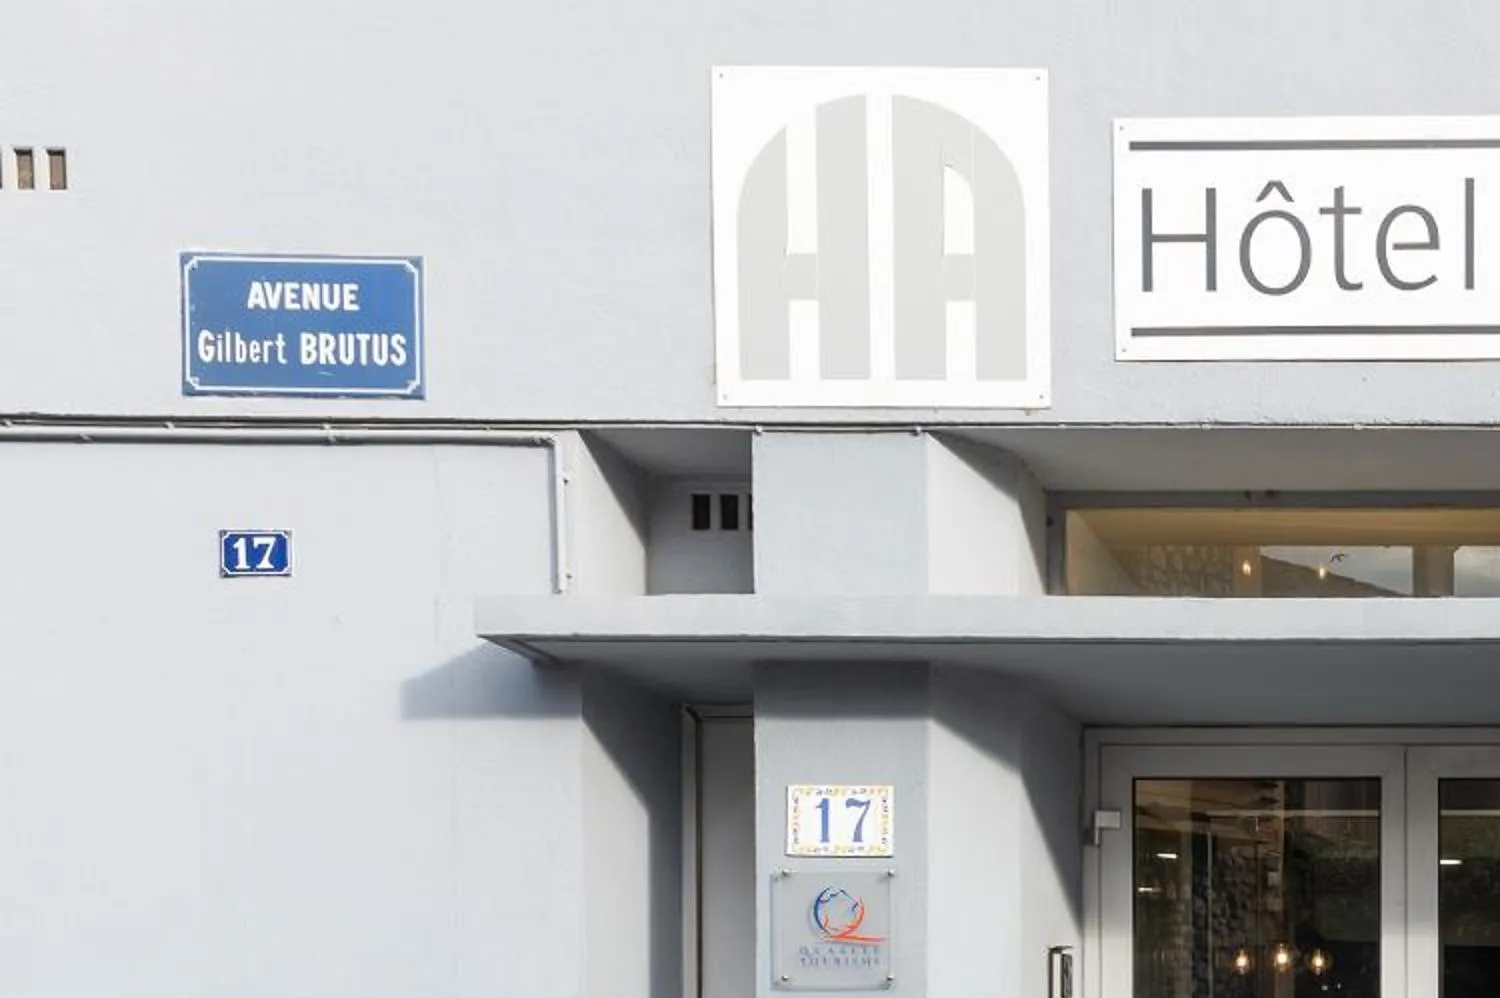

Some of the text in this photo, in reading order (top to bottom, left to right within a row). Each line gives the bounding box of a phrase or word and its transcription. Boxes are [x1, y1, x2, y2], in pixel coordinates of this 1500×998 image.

[1141, 178, 1475, 296] Hôtel
[247, 281, 360, 311] AVENUE
[197, 329, 407, 367] Gilbert BRUTUS
[231, 536, 276, 570] 17
[814, 797, 871, 843] 17
